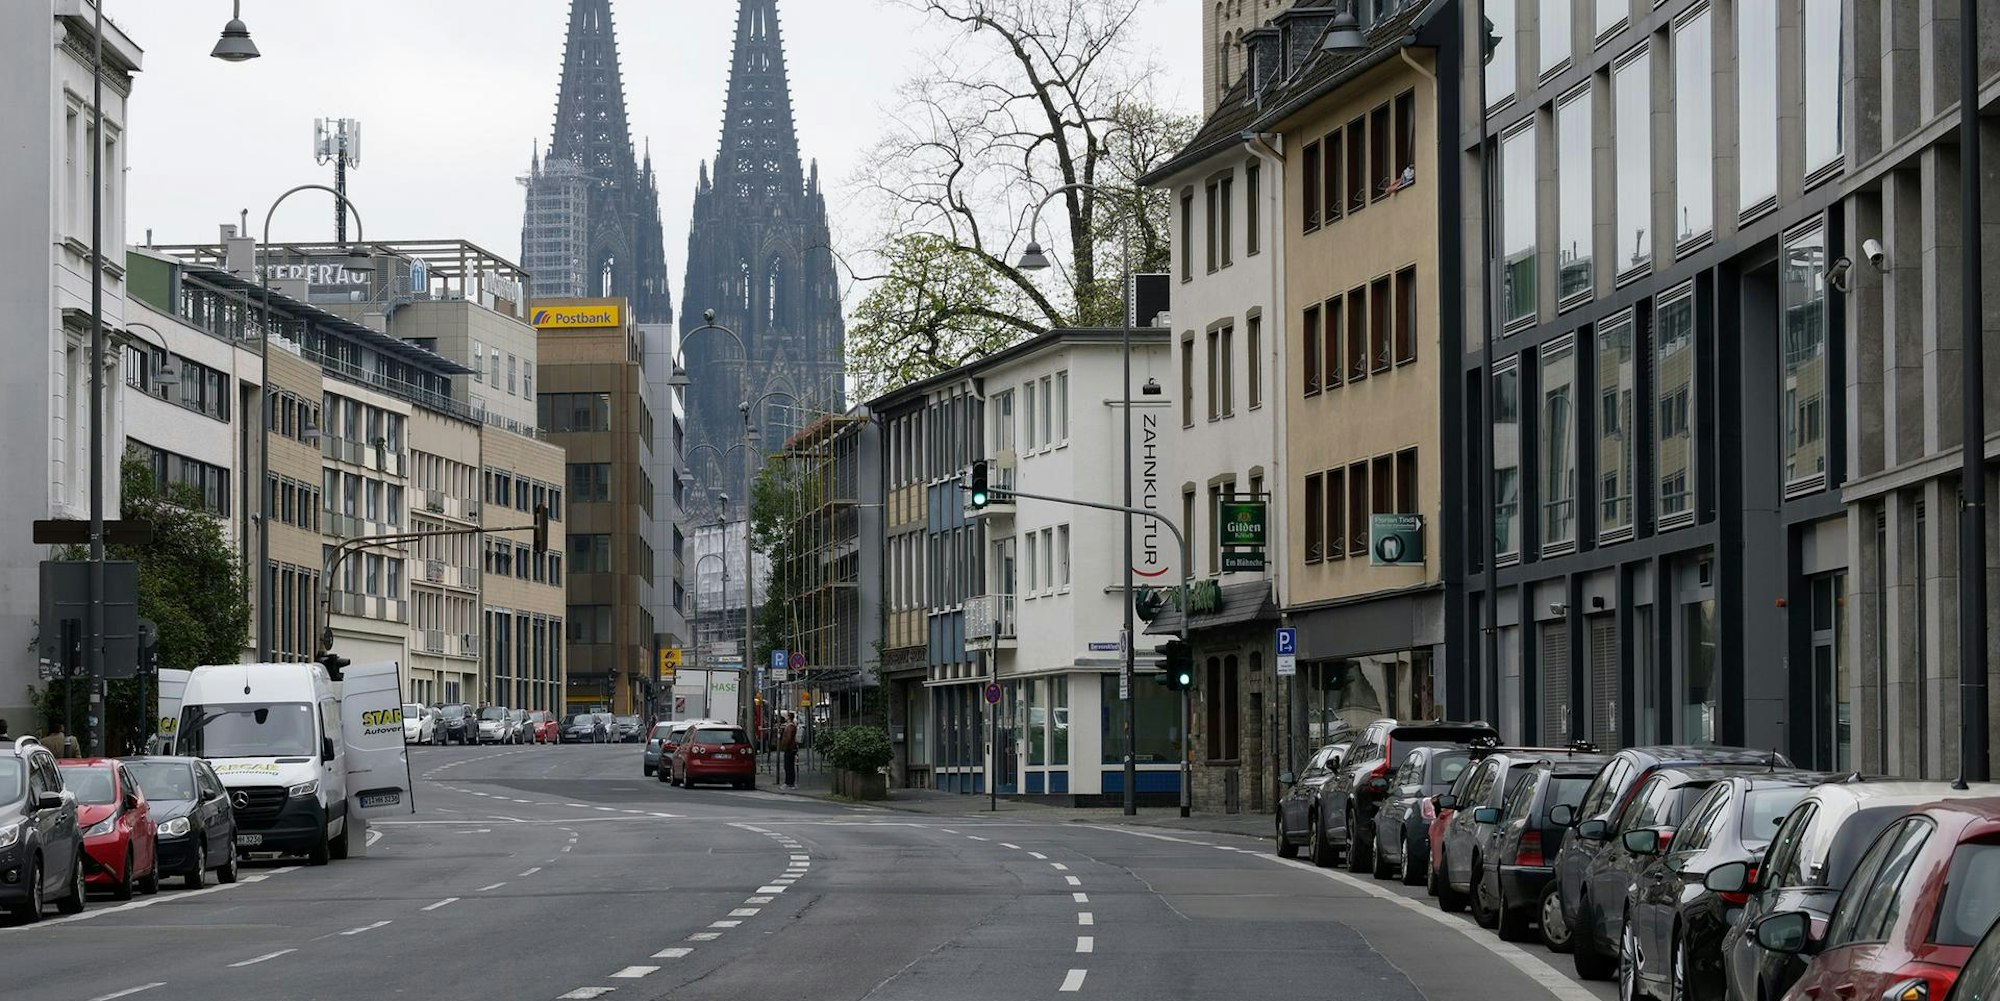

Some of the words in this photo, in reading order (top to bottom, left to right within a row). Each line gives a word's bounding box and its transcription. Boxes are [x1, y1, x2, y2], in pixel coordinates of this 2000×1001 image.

[556, 313, 610, 324] Postbank
[1227, 521, 1261, 532] Gilden
[1280, 631, 1290, 651] P
[711, 682, 737, 693] HASE
